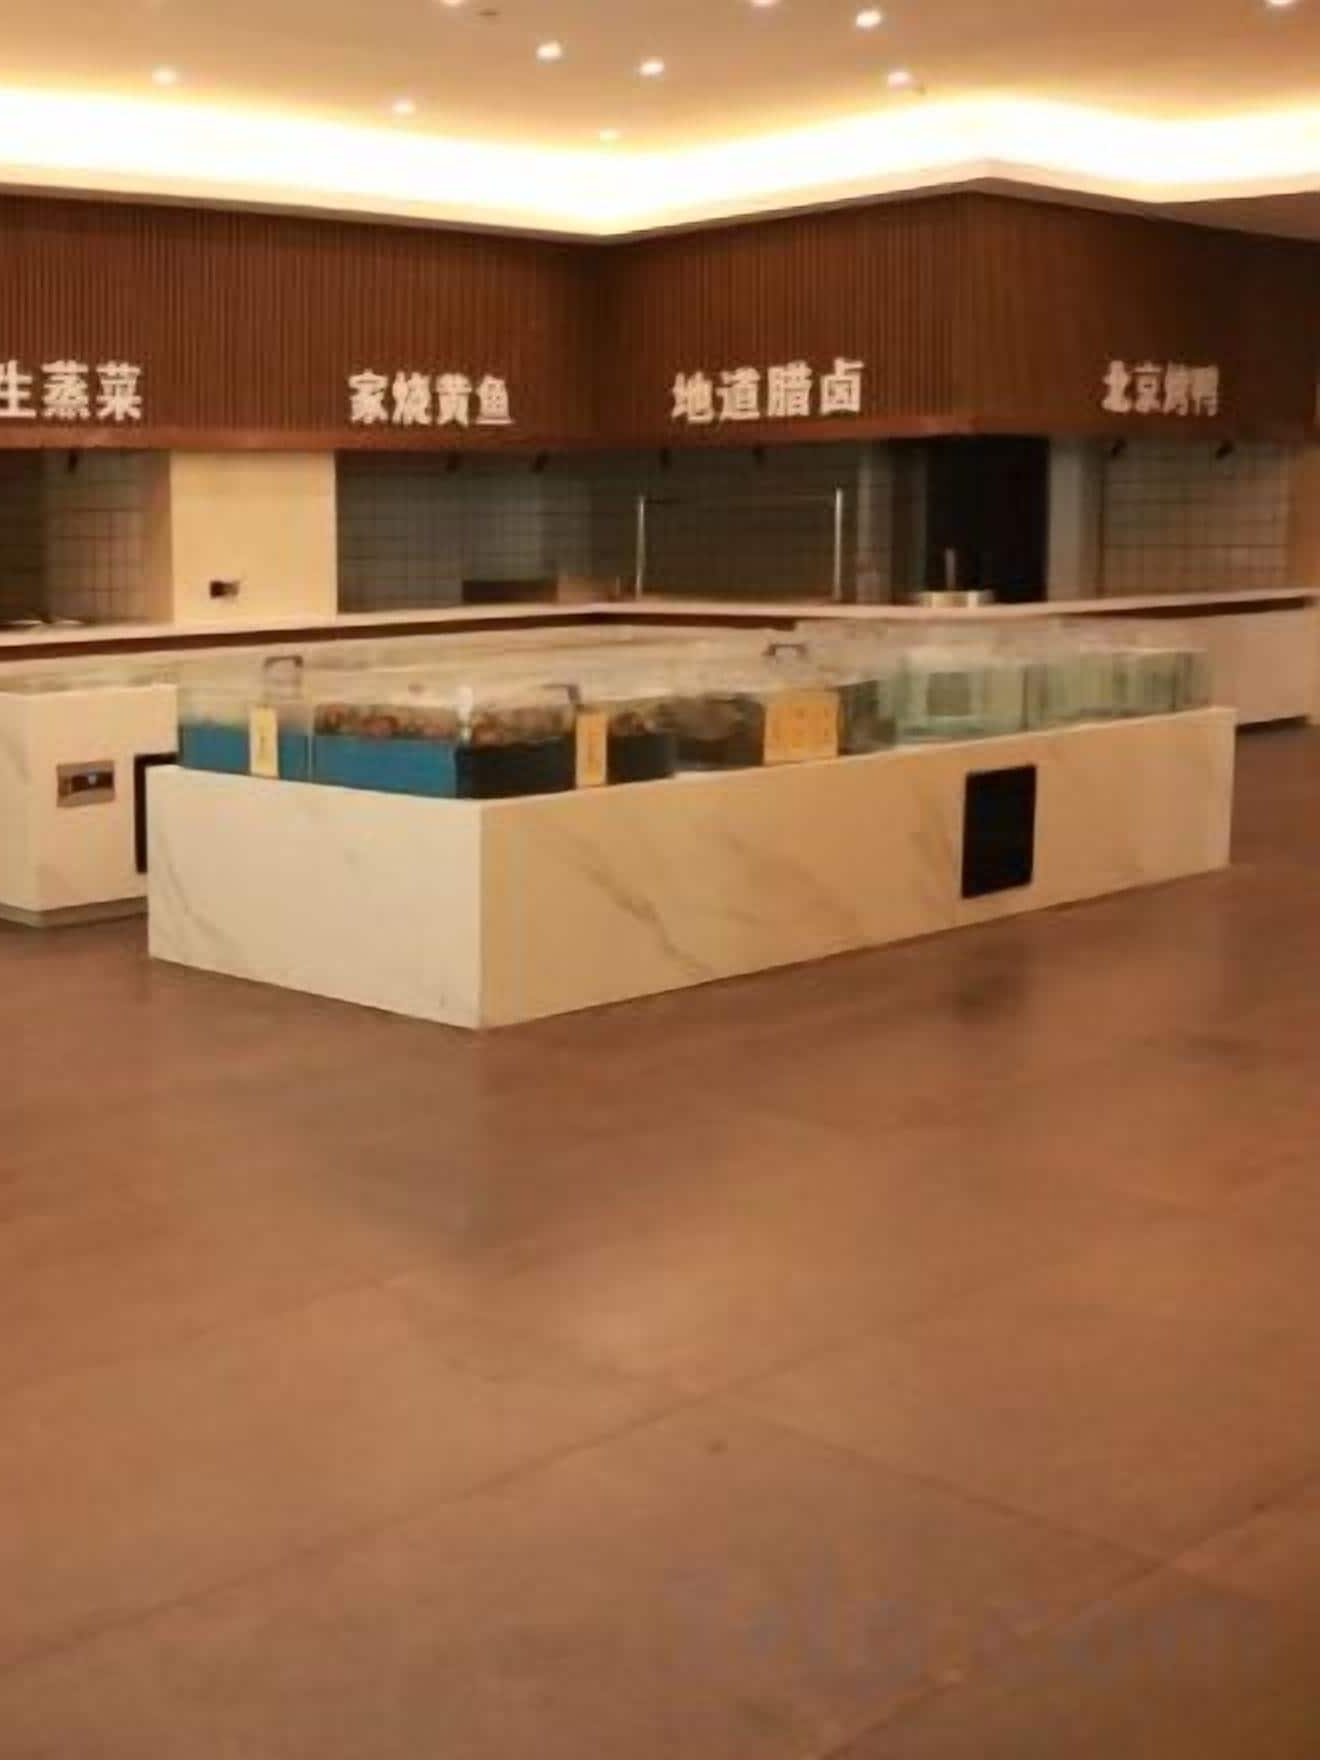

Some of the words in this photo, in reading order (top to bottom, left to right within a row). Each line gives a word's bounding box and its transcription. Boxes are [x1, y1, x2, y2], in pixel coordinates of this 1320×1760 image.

[348, 369, 514, 427] 家烧黄鱼
[671, 357, 864, 423] 地道腊卤
